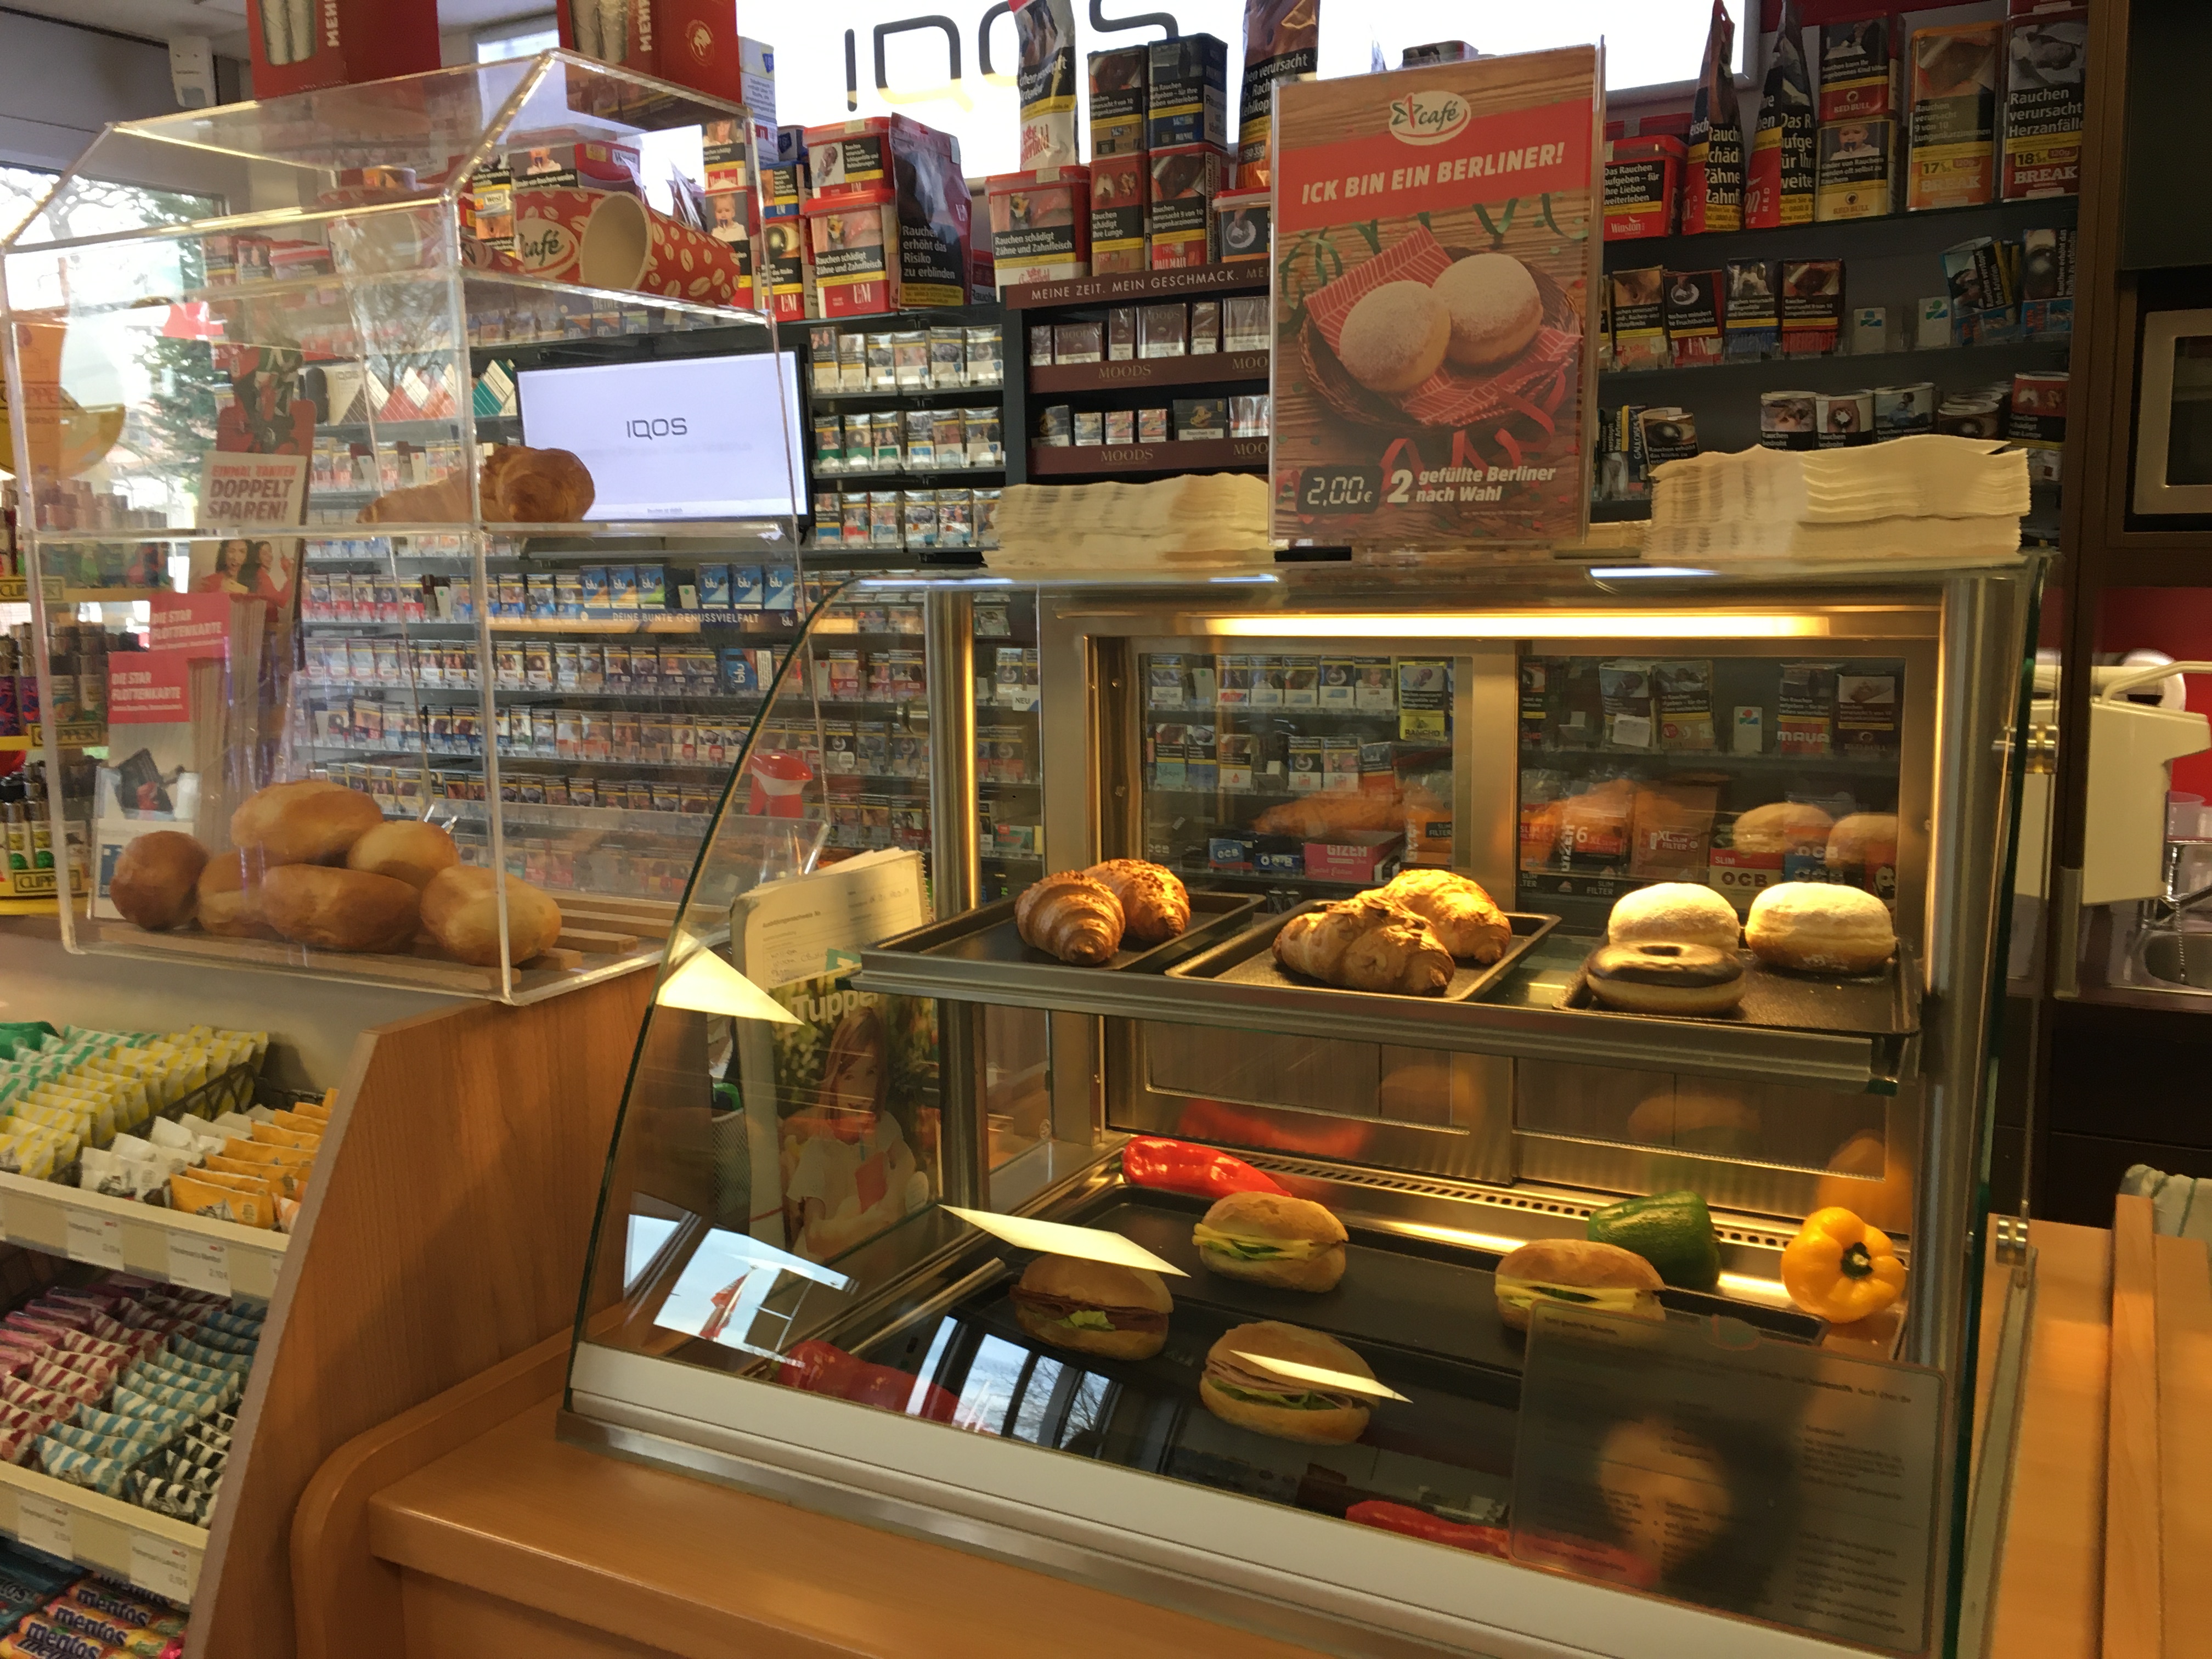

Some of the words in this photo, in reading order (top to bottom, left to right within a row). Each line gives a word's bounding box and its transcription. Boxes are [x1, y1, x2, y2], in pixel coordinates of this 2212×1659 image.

[1259, 53, 1308, 77] verursacht
[2011, 89, 2069, 105] Rauchen
[1418, 101, 1459, 132] café
[2010, 101, 2083, 121] verursacht
[1302, 179, 1339, 204] ICK
[1345, 172, 1385, 198] BIN
[1391, 165, 1430, 190] EIN
[1437, 142, 1565, 183] BERLINER!
[1620, 164, 1652, 174] Rauchen
[1647, 172, 1660, 180] für
[2015, 166, 2078, 184] BREAK
[1620, 184, 1646, 193] Lieben
[1604, 195, 1650, 205] weiterleben
[1104, 229, 1124, 238] Lunge
[1611, 223, 1641, 233] Winston
[904, 239, 933, 250] erhöht
[934, 242, 947, 252] das
[995, 235, 1024, 245] Rauchen
[1025, 232, 1054, 242] schädigt
[996, 246, 1016, 256] Zähne
[1018, 244, 1030, 253] und
[1032, 240, 1073, 252] Zahnfleisch
[816, 255, 840, 265] Rauchen
[840, 251, 866, 262] schädigt
[904, 252, 931, 264] Risiko
[835, 263, 847, 273] und
[848, 259, 883, 271] Zahnfleisch
[918, 267, 955, 279] erblinden
[1031, 287, 1069, 300] MEINE
[1076, 284, 1105, 296] ZEIT.
[1112, 279, 1144, 292] MEIN
[1151, 269, 1239, 289] GESCHMACK.
[1098, 364, 1151, 379] MOODS
[627, 417, 688, 440] IQOS
[1101, 448, 1153, 462] MOODS
[1419, 467, 1483, 485] gefüllte
[1487, 466, 1556, 483] Berliner
[210, 479, 294, 498] DOPPELT
[1387, 469, 1413, 503] 2
[1416, 486, 1455, 502] nach
[1459, 486, 1503, 501] Wahl
[206, 500, 288, 521] SPAREN!
[613, 612, 638, 623] DEINE
[642, 612, 673, 623] BUNTE
[676, 613, 759, 624] GENUSSVIELFALT
[1405, 729, 1441, 737] RANCHO
[1576, 826, 1588, 843] 6
[1657, 830, 1673, 842] XL
[1327, 844, 1367, 857] GIZEH
[1662, 842, 1687, 850] FILTER
[1217, 848, 1239, 859] OCB
[1715, 856, 1735, 865] SLIM
[1722, 871, 1768, 888] OCB
[1587, 887, 1613, 895] FILTER
[76, 1588, 150, 1627] mentos
[56, 1607, 128, 1646] mentos
[26, 1622, 101, 1658] mentos
